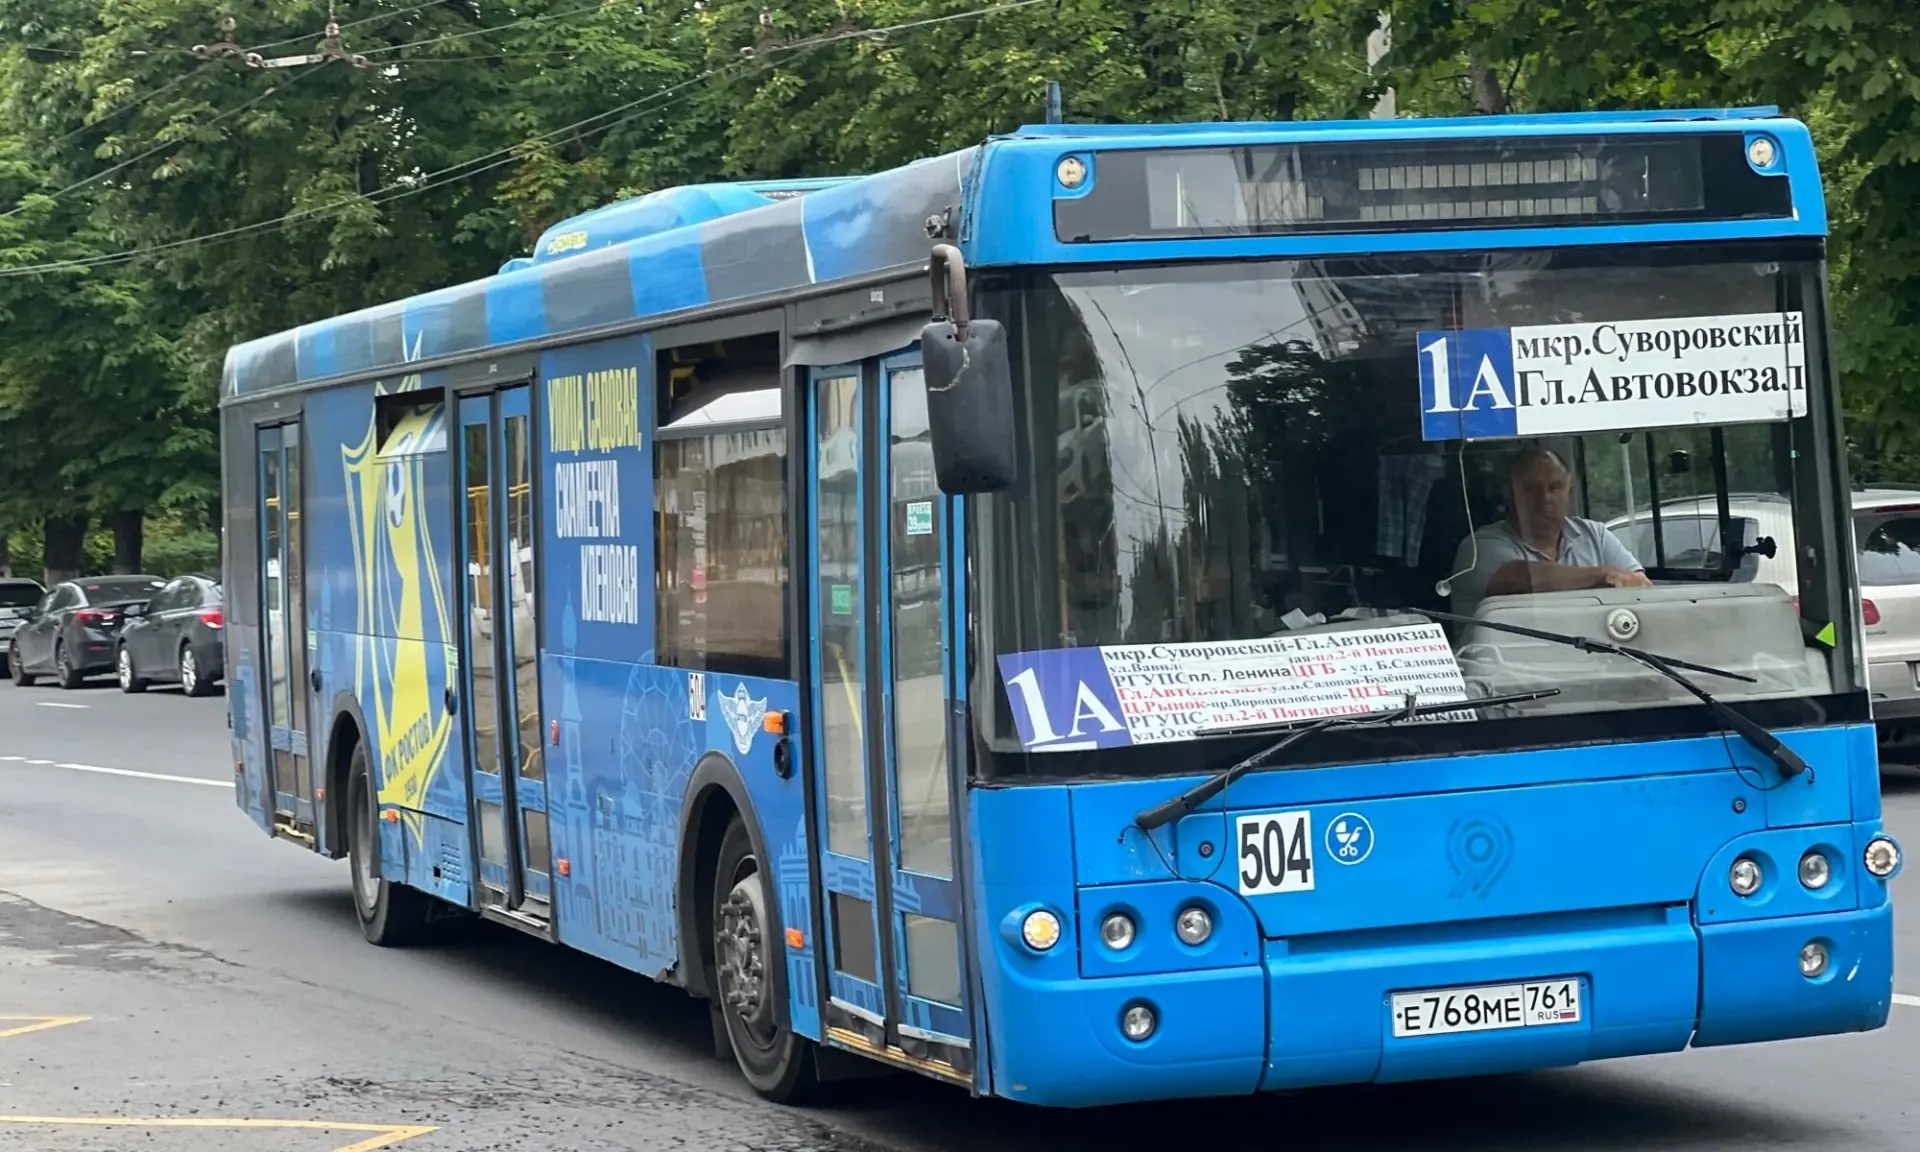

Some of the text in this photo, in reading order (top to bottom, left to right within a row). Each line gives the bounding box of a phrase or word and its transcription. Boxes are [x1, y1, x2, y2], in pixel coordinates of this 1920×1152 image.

[1516, 315, 1801, 365] мкр.Суворовский
[1420, 337, 1515, 413] 1А
[1517, 363, 1804, 408] Гл.Автовокзал
[548, 367, 642, 455] УЛИЦА САДОВАЯ,
[556, 460, 620, 538] СКАМЕЕЧКА
[581, 544, 638, 624] КЛЕНОВАЯ
[1109, 663, 1183, 675] ул.Вавил
[1114, 672, 1188, 687] РГУПС
[1188, 674, 1218, 683] пл.
[1222, 666, 1292, 681] Ленина
[1292, 662, 1337, 678] ЦГБ
[1376, 656, 1454, 671] Б.Садовая
[689, 673, 705, 719] 504
[1007, 665, 1127, 746] 1А
[1133, 725, 1204, 744] ул.Осо
[1240, 817, 1311, 889] 504
[1526, 983, 1573, 1010] 761
[1537, 1009, 1559, 1021] RUS
